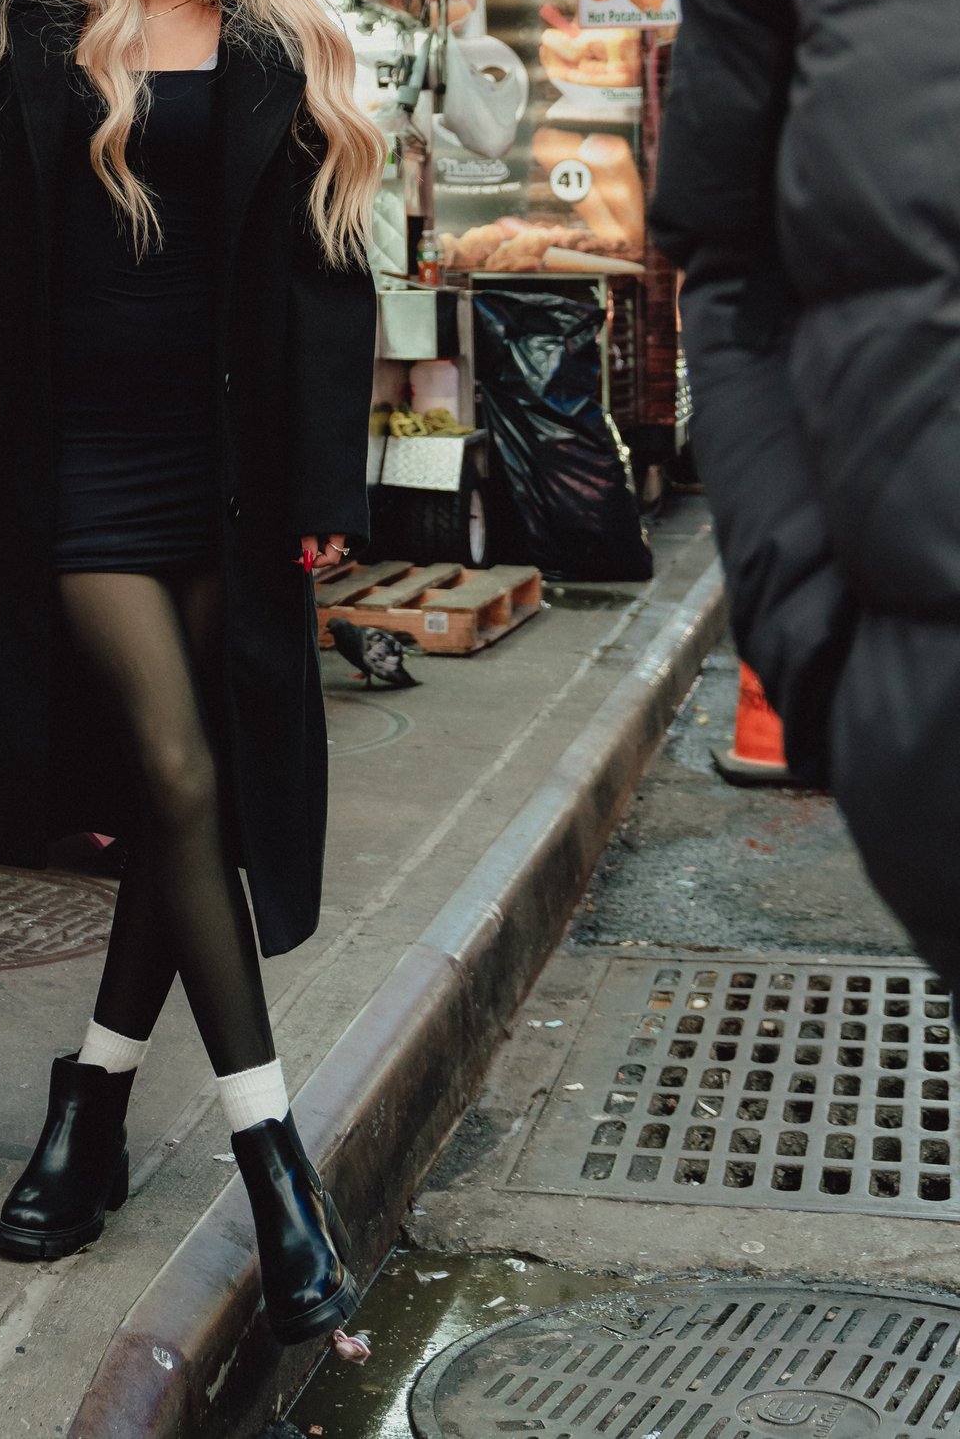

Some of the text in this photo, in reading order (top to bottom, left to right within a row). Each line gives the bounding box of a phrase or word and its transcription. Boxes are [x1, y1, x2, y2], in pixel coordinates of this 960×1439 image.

[588, 11, 605, 23] Hot
[608, 10, 642, 22] Potato
[557, 170, 584, 188] 41
